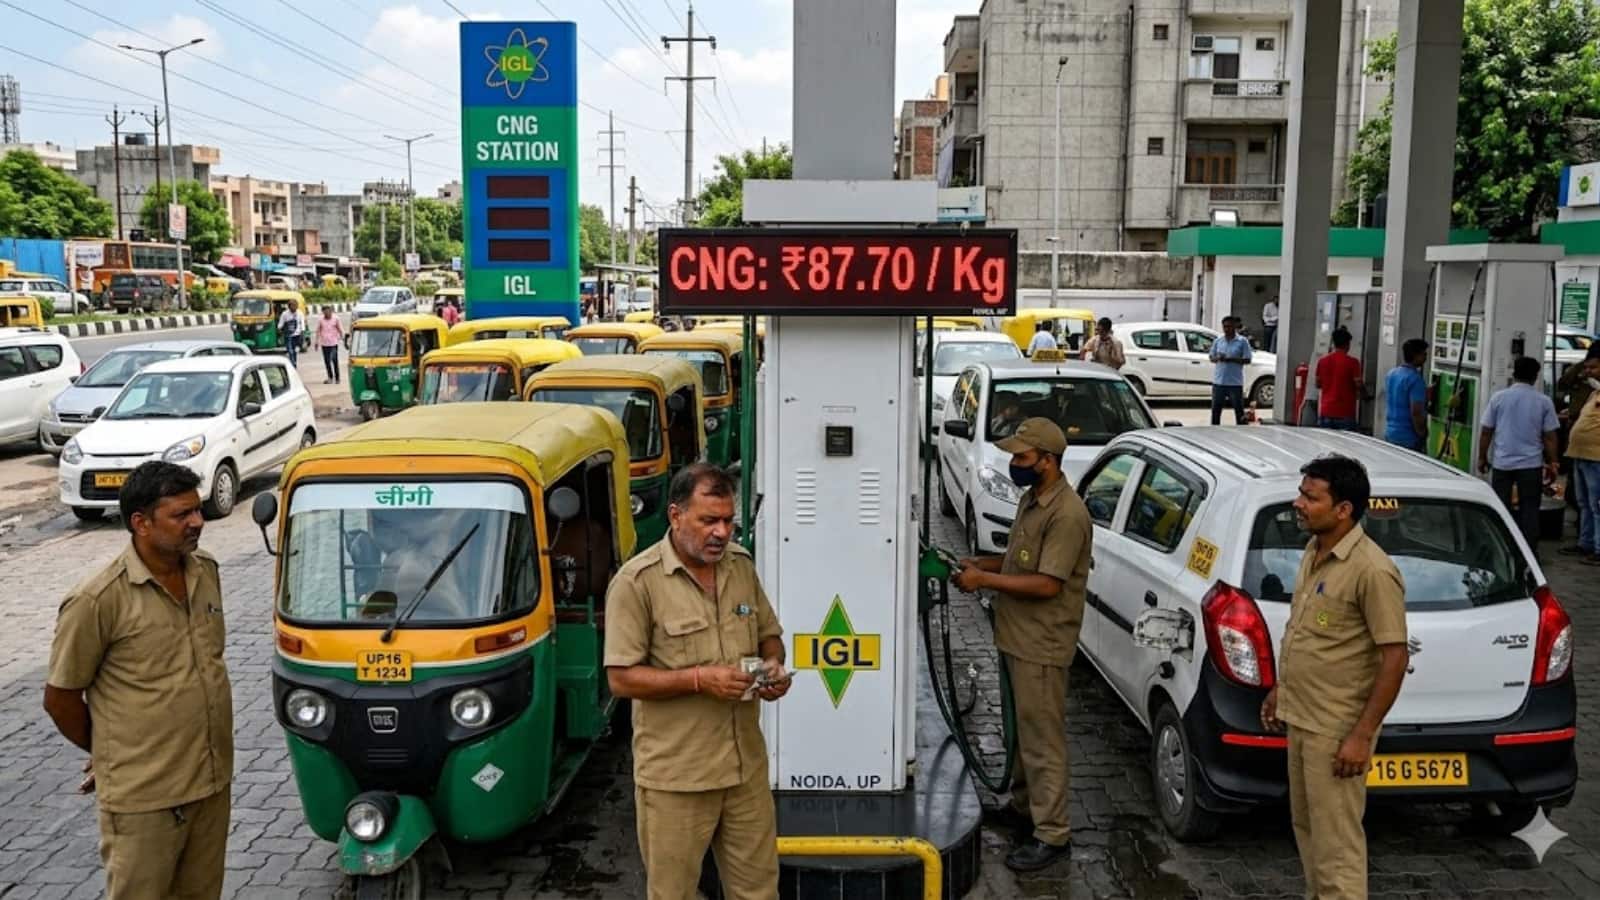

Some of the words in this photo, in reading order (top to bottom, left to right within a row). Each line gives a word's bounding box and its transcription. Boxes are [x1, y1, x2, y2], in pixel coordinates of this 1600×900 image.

[501, 55, 534, 72] IGL
[496, 114, 539, 135] CNG
[476, 141, 559, 161] STATION
[670, 246, 768, 291] CNG:
[781, 246, 915, 291] ₹87.70
[926, 246, 941, 292] /
[953, 246, 1006, 303] Kg
[503, 275, 537, 295] IGL
[1367, 498, 1399, 509] TAXI
[1491, 634, 1529, 645] ALTO
[366, 653, 402, 665] UP16
[811, 637, 873, 667] IGL
[361, 667, 370, 678] T
[375, 667, 407, 678] 1234
[1369, 759, 1397, 780] 16
[1401, 760, 1412, 780] G
[1416, 759, 1463, 780] 5678
[857, 775, 881, 789] UP
